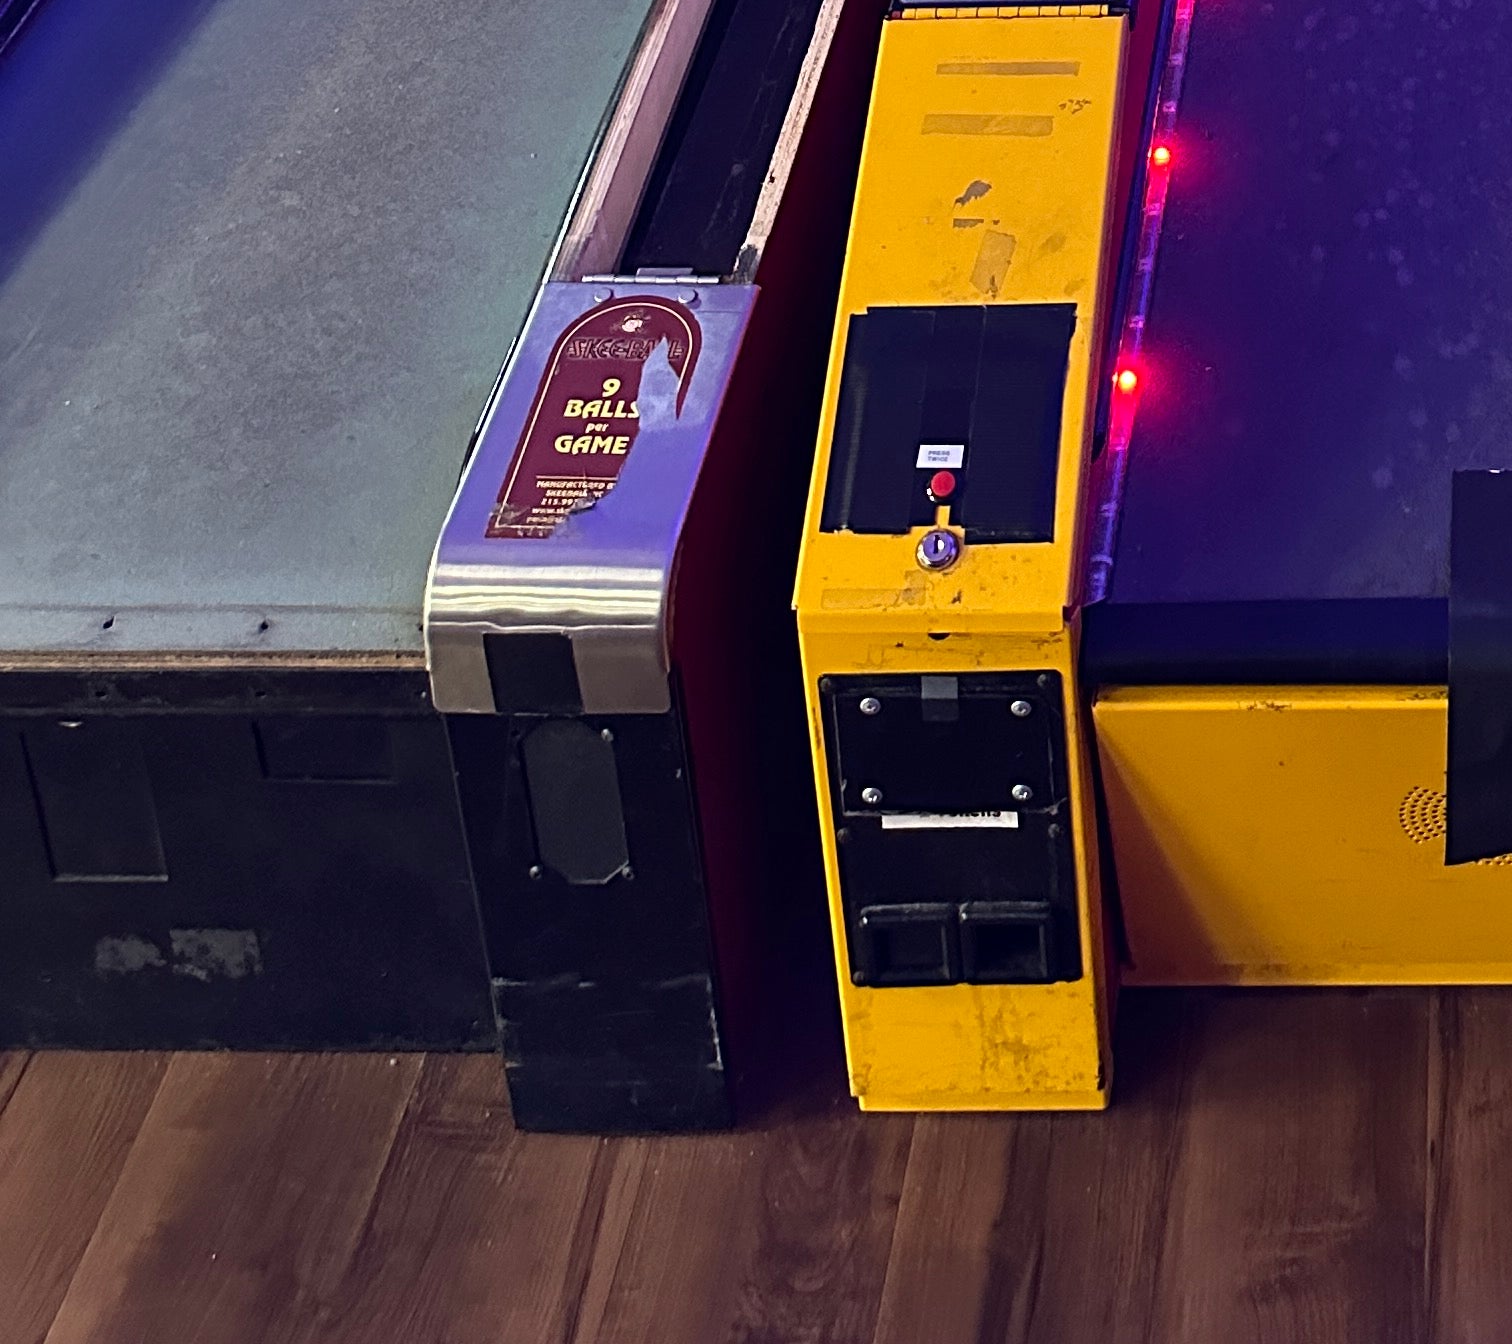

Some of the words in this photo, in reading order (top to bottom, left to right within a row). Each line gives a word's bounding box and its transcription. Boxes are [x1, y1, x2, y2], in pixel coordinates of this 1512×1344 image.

[602, 378, 622, 398] 9
[564, 399, 640, 419] BALLS
[585, 422, 609, 433] per
[554, 435, 630, 456] GAME
